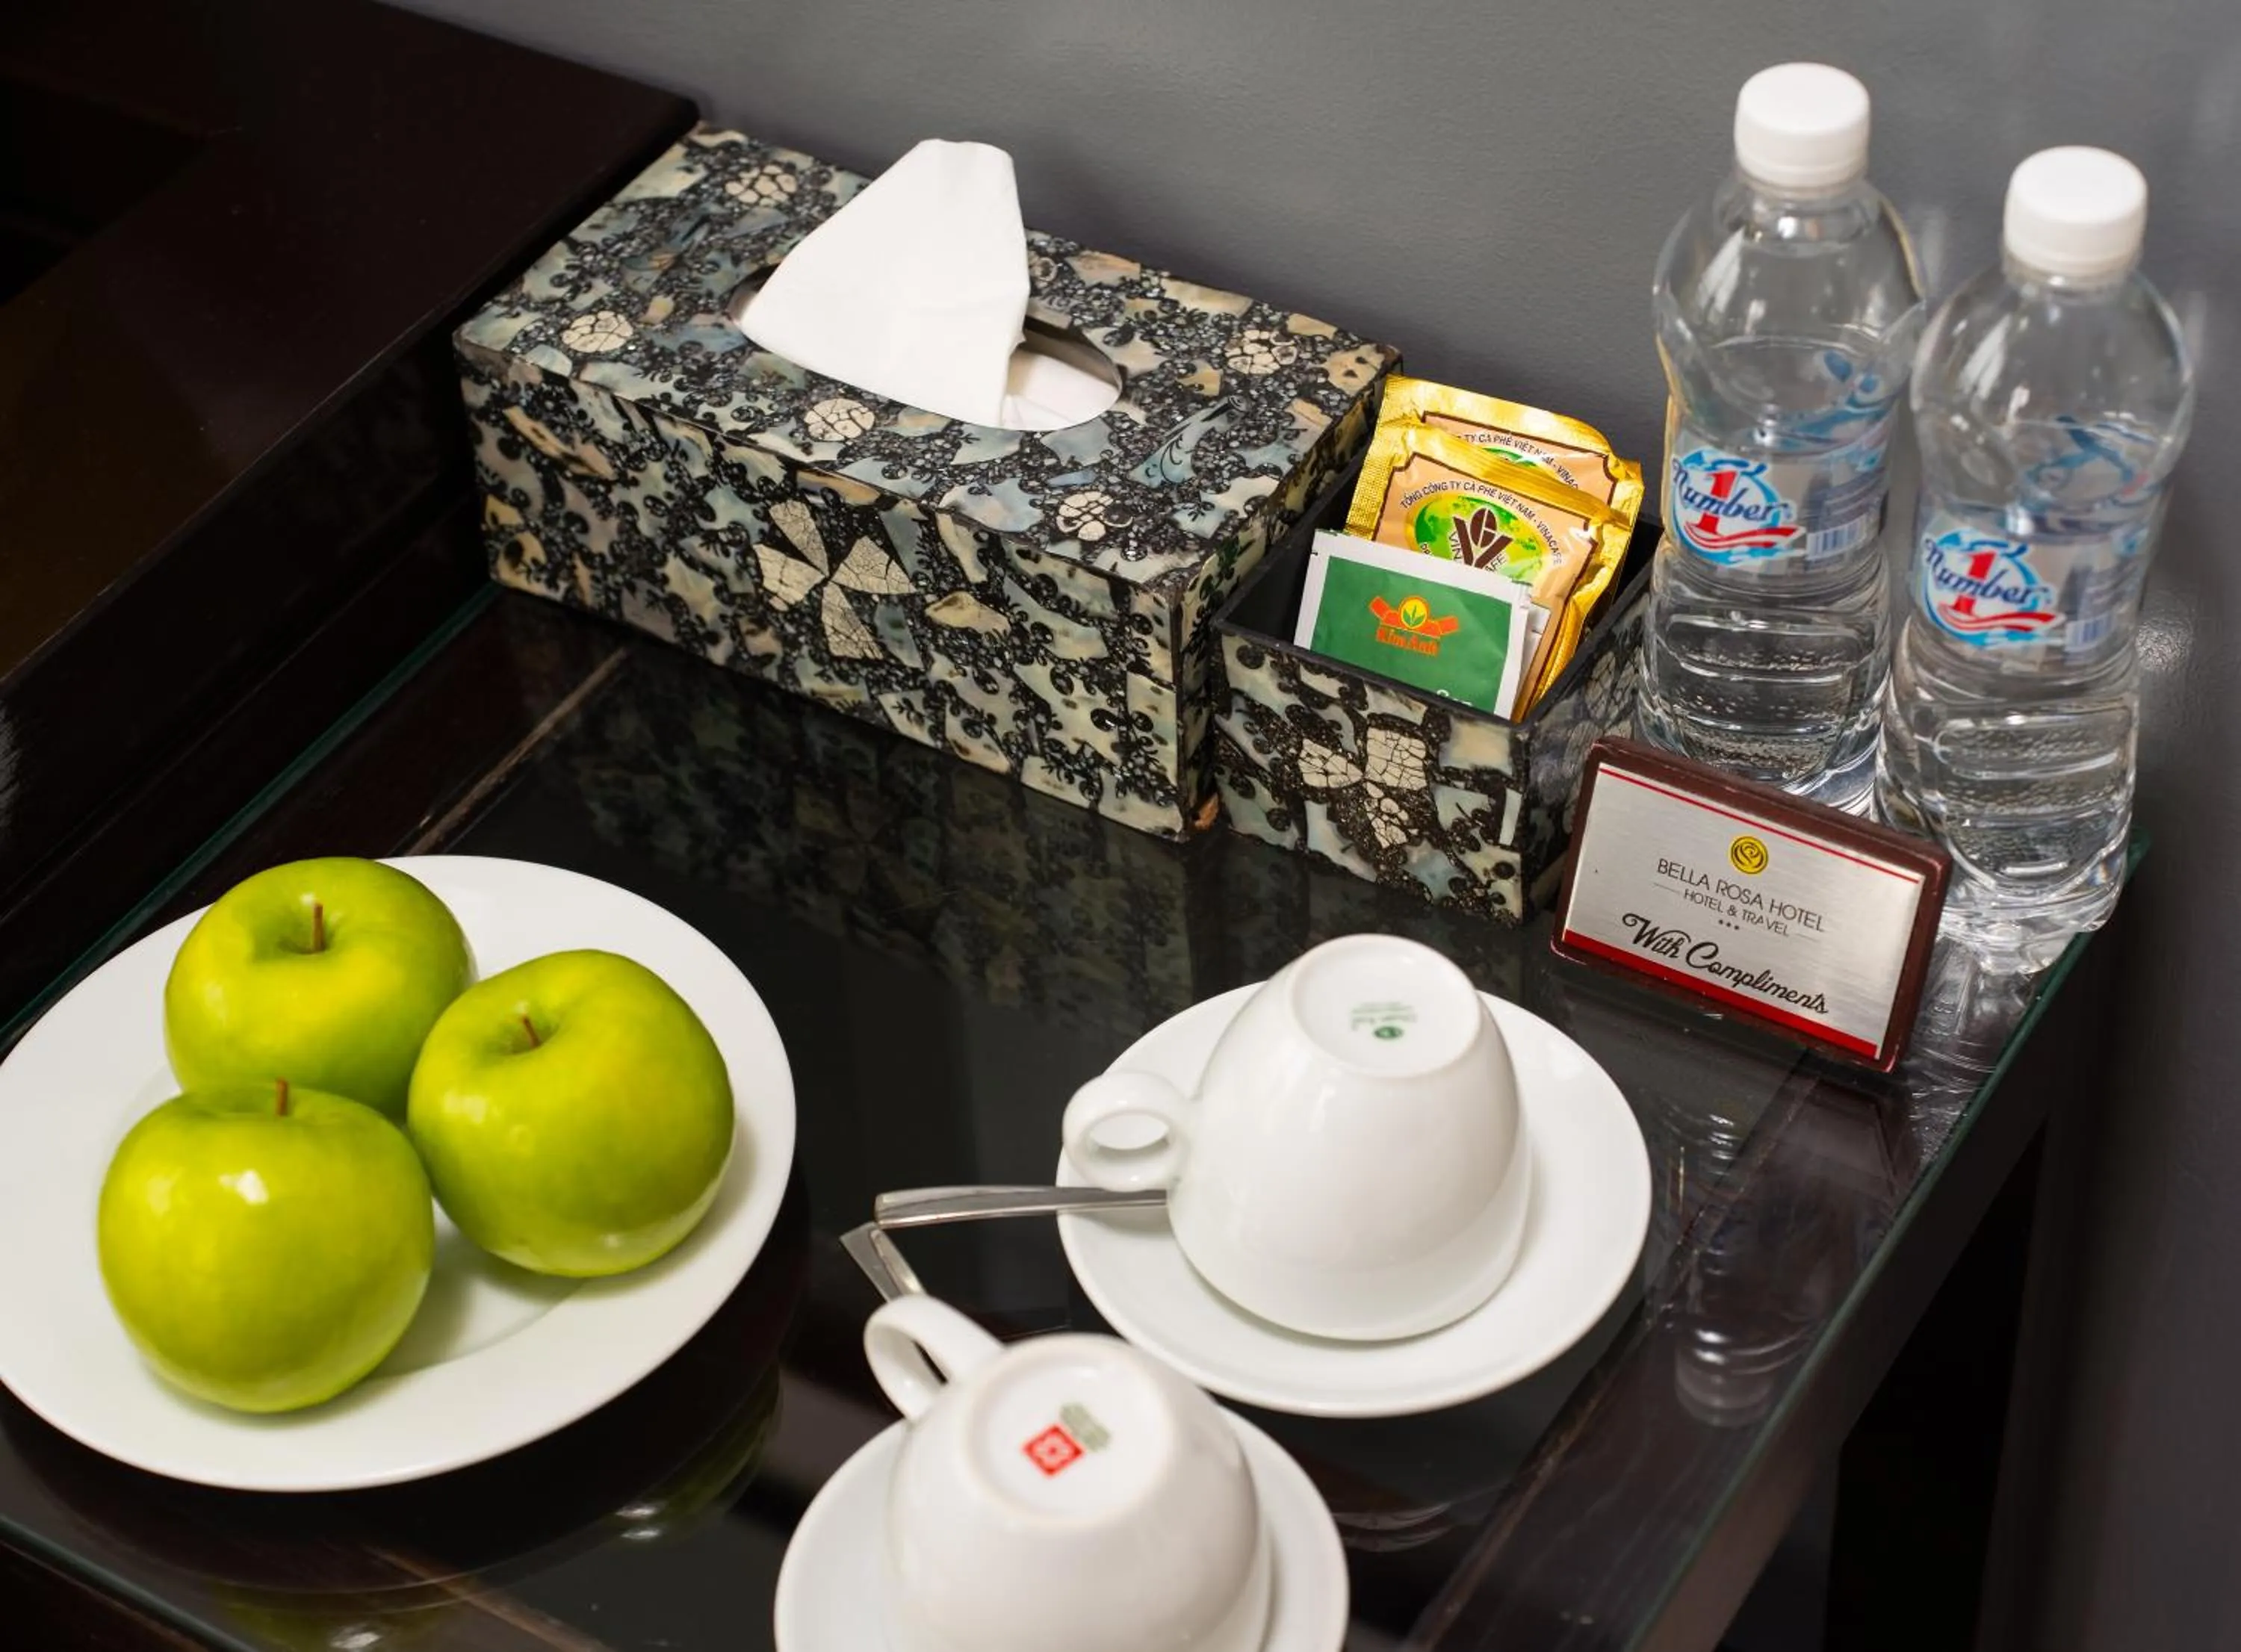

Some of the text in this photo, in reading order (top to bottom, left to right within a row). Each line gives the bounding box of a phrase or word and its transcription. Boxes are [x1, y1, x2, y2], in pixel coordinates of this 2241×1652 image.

[1449, 480, 1462, 491] TY
[1516, 503, 1536, 521] NAM
[1673, 457, 1789, 535] Number 1
[1925, 538, 2049, 615] Number 1
[1658, 858, 1825, 933] BELLA ROSA HOTEL
[1684, 888, 1790, 937] HOTEL & TRAVEL
[1622, 913, 1829, 1015] With Compliments
